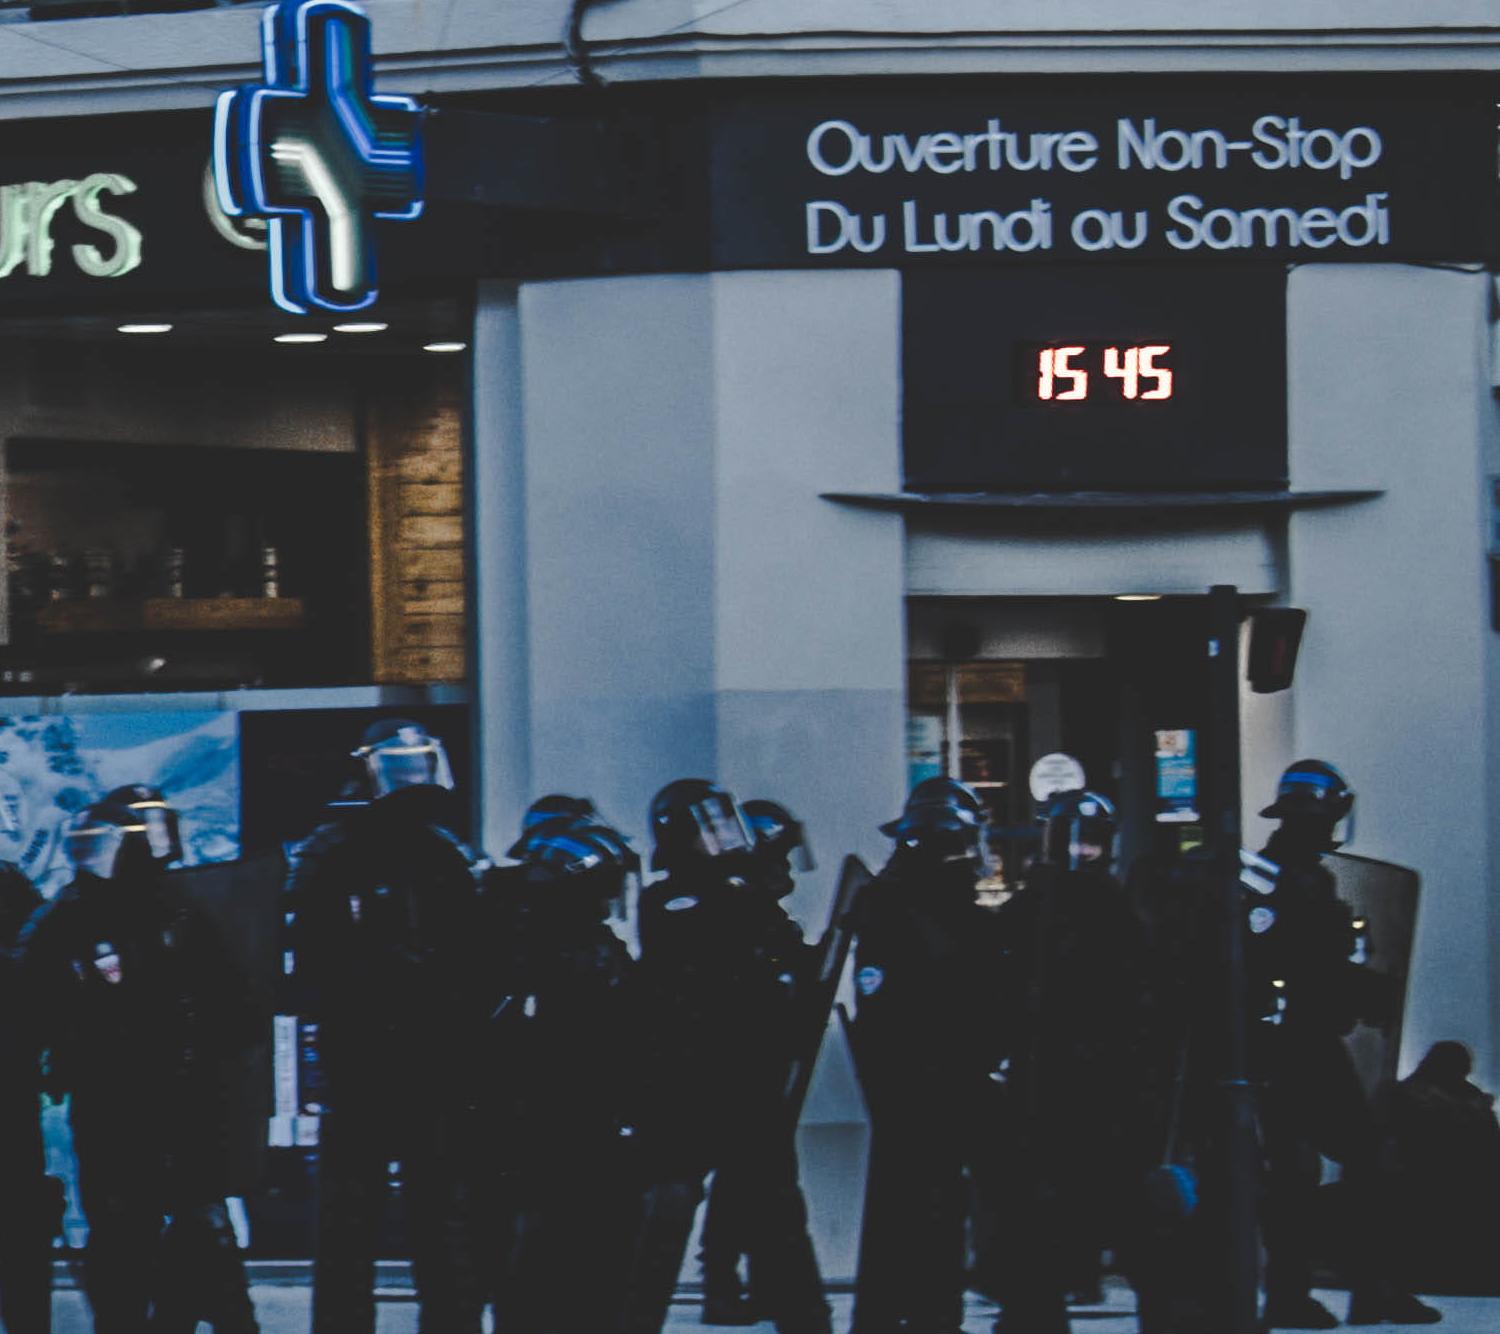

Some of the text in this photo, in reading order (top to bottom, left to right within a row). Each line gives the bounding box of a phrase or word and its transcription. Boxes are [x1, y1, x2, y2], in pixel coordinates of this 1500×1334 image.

[807, 116, 1382, 180] Ouverture Non-Stop
[806, 191, 1391, 254] Du Lundi au Samedi
[1037, 345, 1173, 401] 15 45
